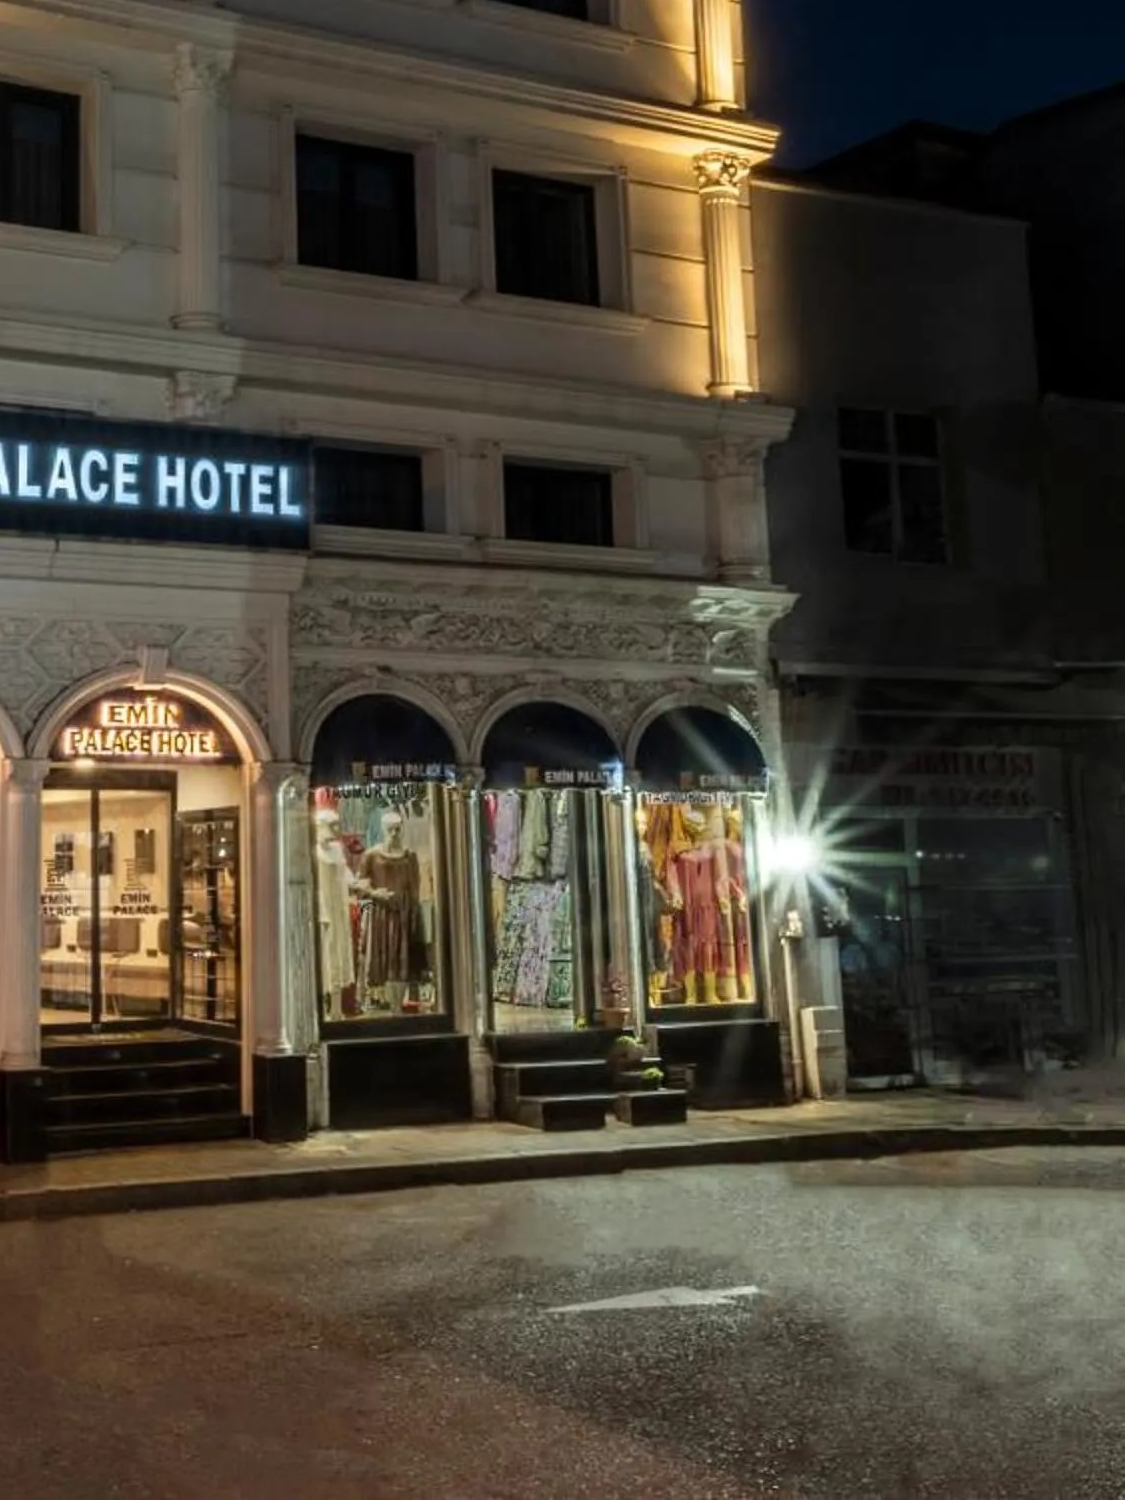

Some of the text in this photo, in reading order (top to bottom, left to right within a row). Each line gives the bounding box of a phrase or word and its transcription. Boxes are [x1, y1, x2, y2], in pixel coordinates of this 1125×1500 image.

[156, 456, 301, 516] HOTEL
[104, 697, 183, 727] EMİN
[66, 728, 152, 755] PALACE
[40, 905, 80, 916] ALACE
